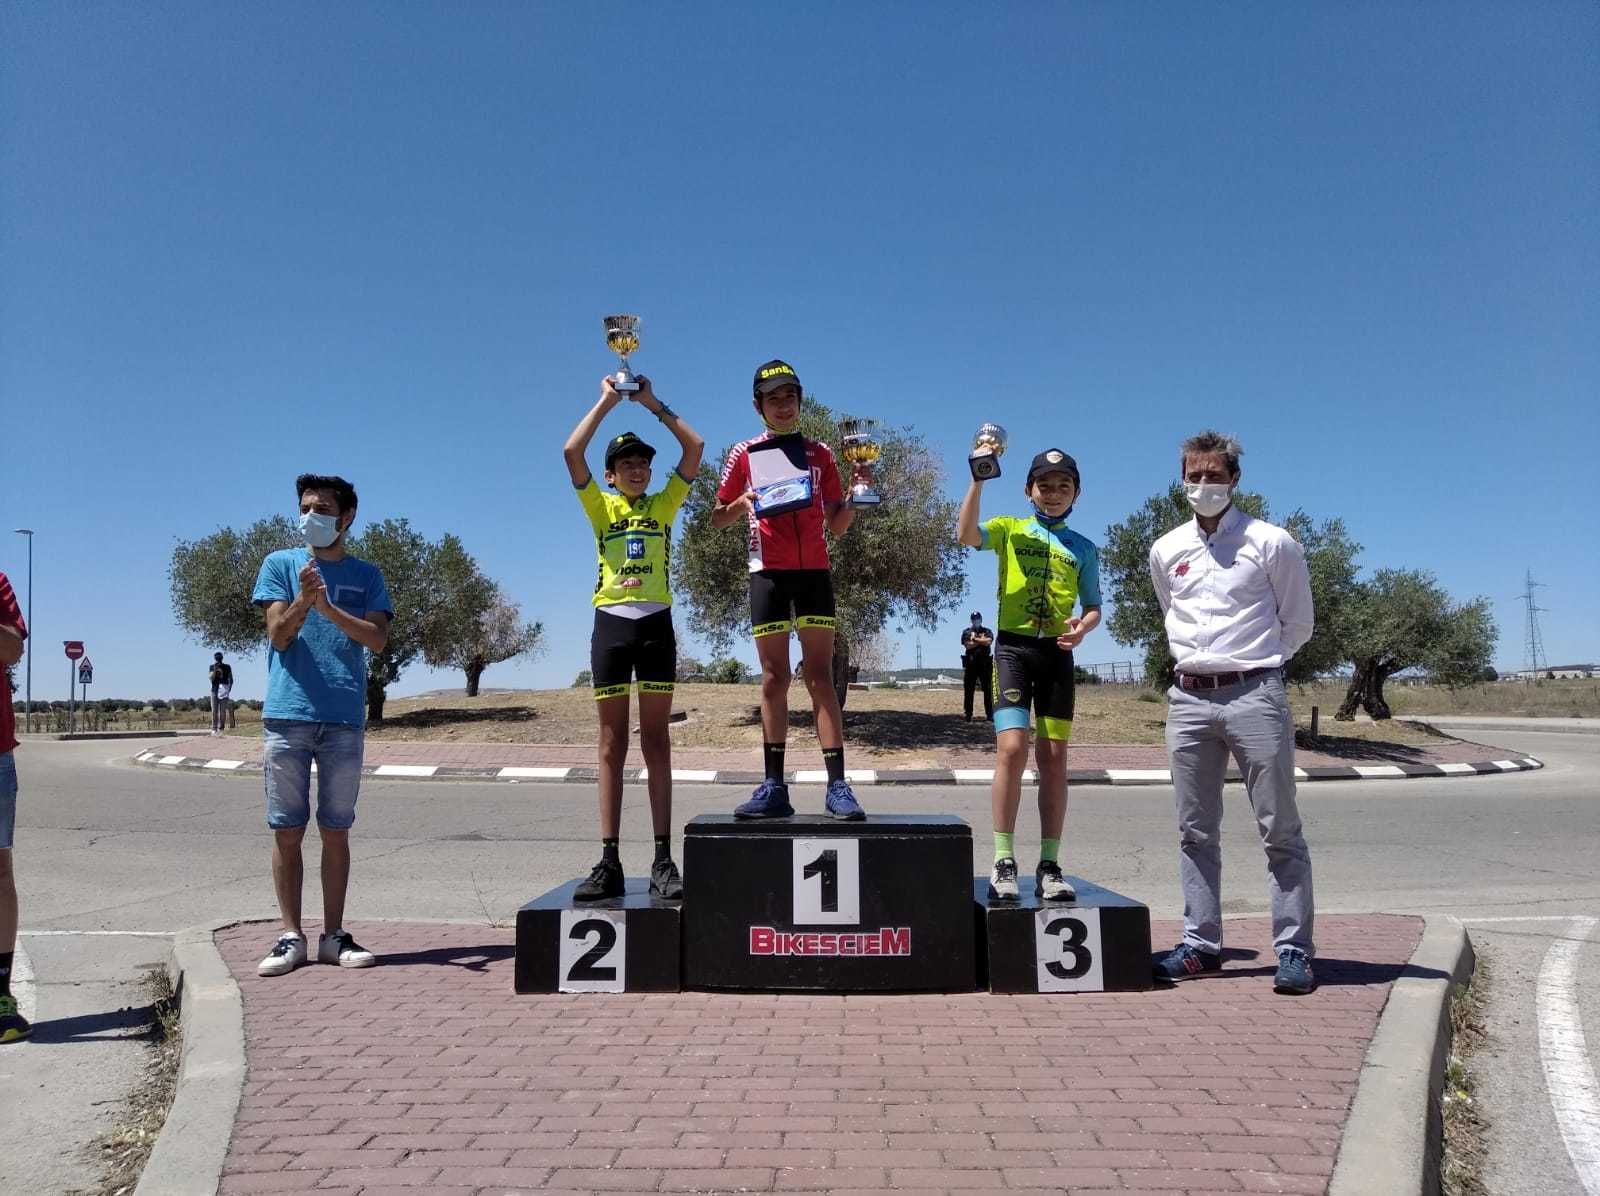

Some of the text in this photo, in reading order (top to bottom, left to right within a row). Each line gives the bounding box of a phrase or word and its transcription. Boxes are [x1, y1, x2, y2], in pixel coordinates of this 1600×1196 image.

[803, 849, 838, 913] 1
[566, 918, 617, 982] 2
[1043, 917, 1092, 980] 3
